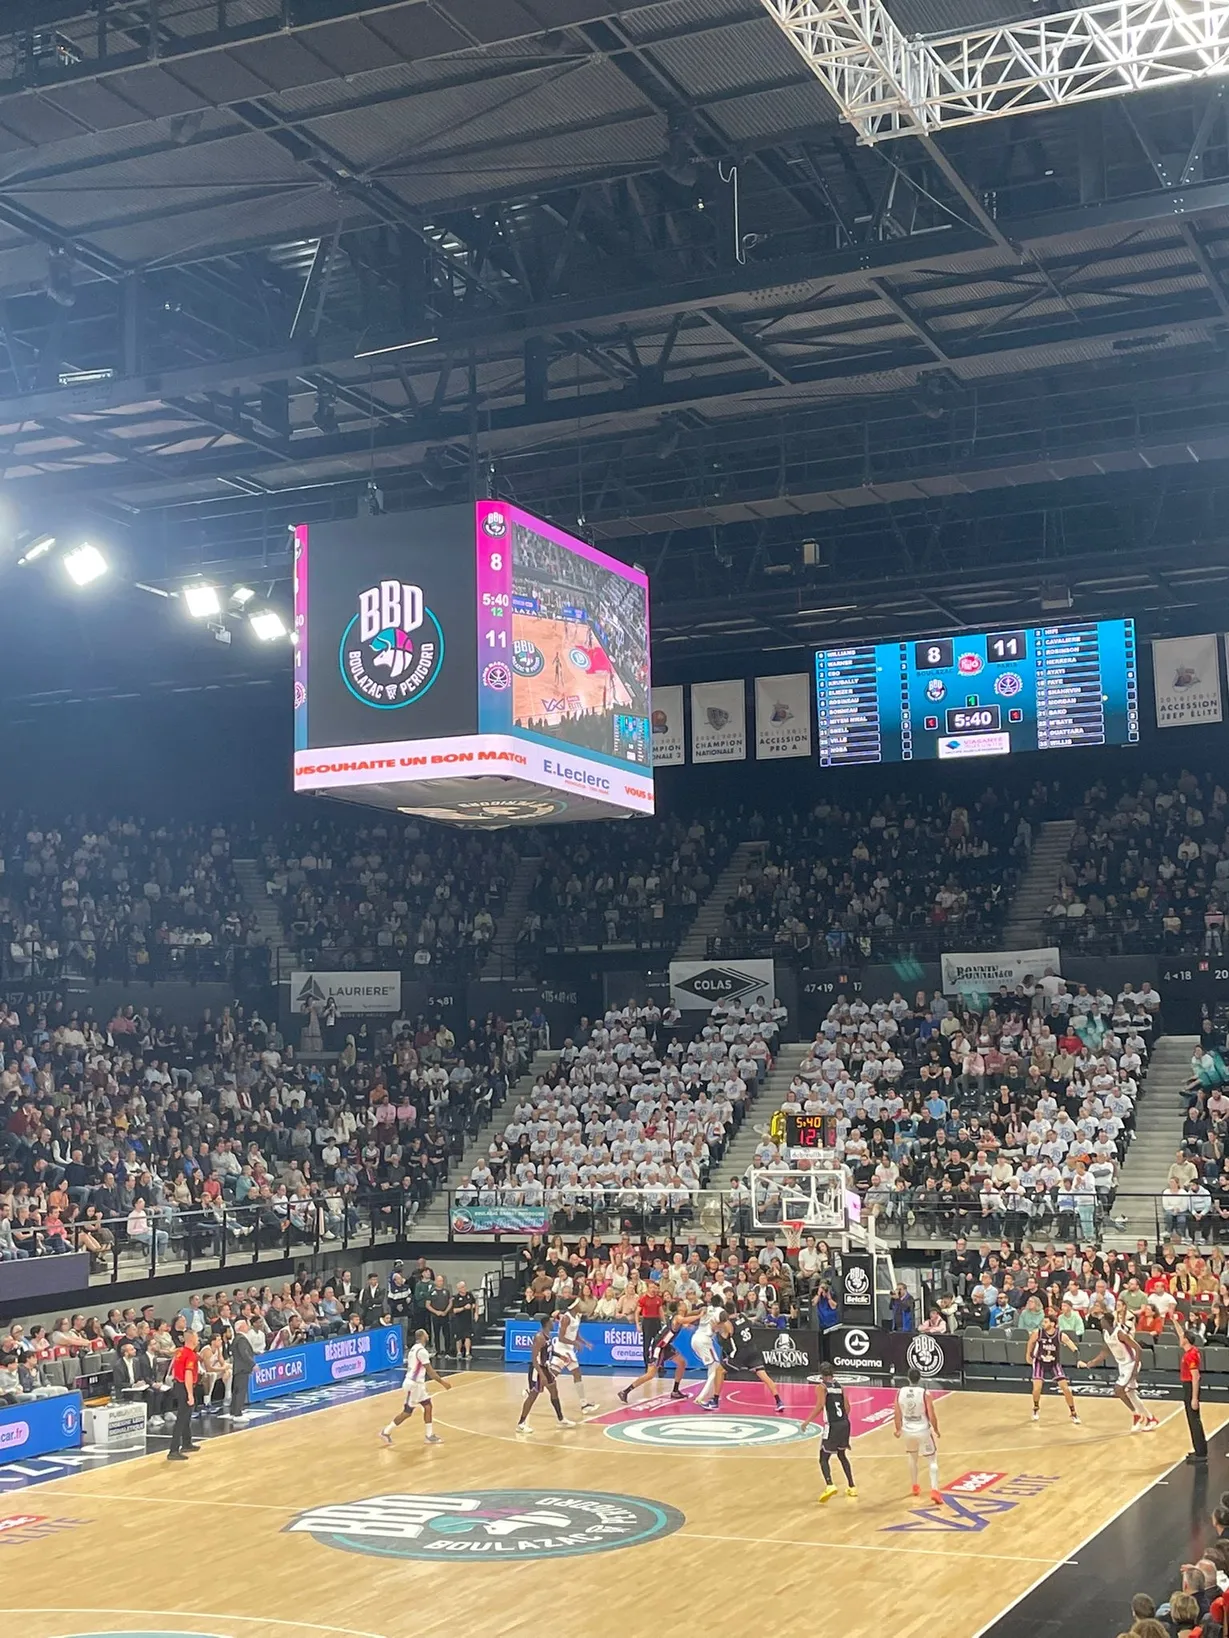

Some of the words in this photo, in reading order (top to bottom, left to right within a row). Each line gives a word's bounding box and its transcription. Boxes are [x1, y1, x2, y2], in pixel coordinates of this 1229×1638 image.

[490, 553, 502, 571] 8
[483, 594, 509, 606] 5:40
[359, 580, 423, 642] BBD
[491, 608, 503, 616] 12
[486, 630, 506, 648] 11
[994, 638, 1017, 656] 11
[928, 647, 940, 663] 8
[349, 650, 384, 699] BOULAZAC
[400, 643, 434, 696] PERIGORD
[1160, 700, 1217, 711] ACCESSION
[954, 712, 992, 727] 5:40
[1161, 712, 1184, 720] JEEP
[695, 740, 742, 749] CHAMPION
[760, 735, 808, 745] ACCESSION
[400, 757, 426, 766] UN
[431, 753, 473, 763] BON
[478, 751, 527, 764] MATCH
[544, 760, 610, 789] E.Leclerc
[625, 786, 646, 798] VOUS
[1164, 972, 1170, 980] 4
[1180, 971, 1191, 980] 18
[1215, 970, 1228, 979] 20
[329, 987, 389, 996] LAURIERE
[694, 979, 732, 990] COLAS
[804, 984, 816, 993] 47
[823, 984, 833, 992] 19
[796, 1117, 822, 1128] 5:40
[800, 1129, 816, 1145] 12
[516, 1336, 533, 1346] REN
[605, 1328, 643, 1344] RÉSERVE
[740, 1328, 751, 1342] 35
[325, 1339, 357, 1361] RÉSERVEZ
[357, 1336, 370, 1352] SUR
[914, 1336, 935, 1353] BBD
[762, 1351, 809, 1366] WATSONS
[834, 1357, 883, 1368] Groupama
[256, 1368, 276, 1384] RENT
[285, 1361, 302, 1376] CAR
[835, 1402, 842, 1417] 5
[1, 1428, 22, 1442] car.fr
[290, 1494, 480, 1538] BBD
[423, 1532, 603, 1552] BOULAZAC
